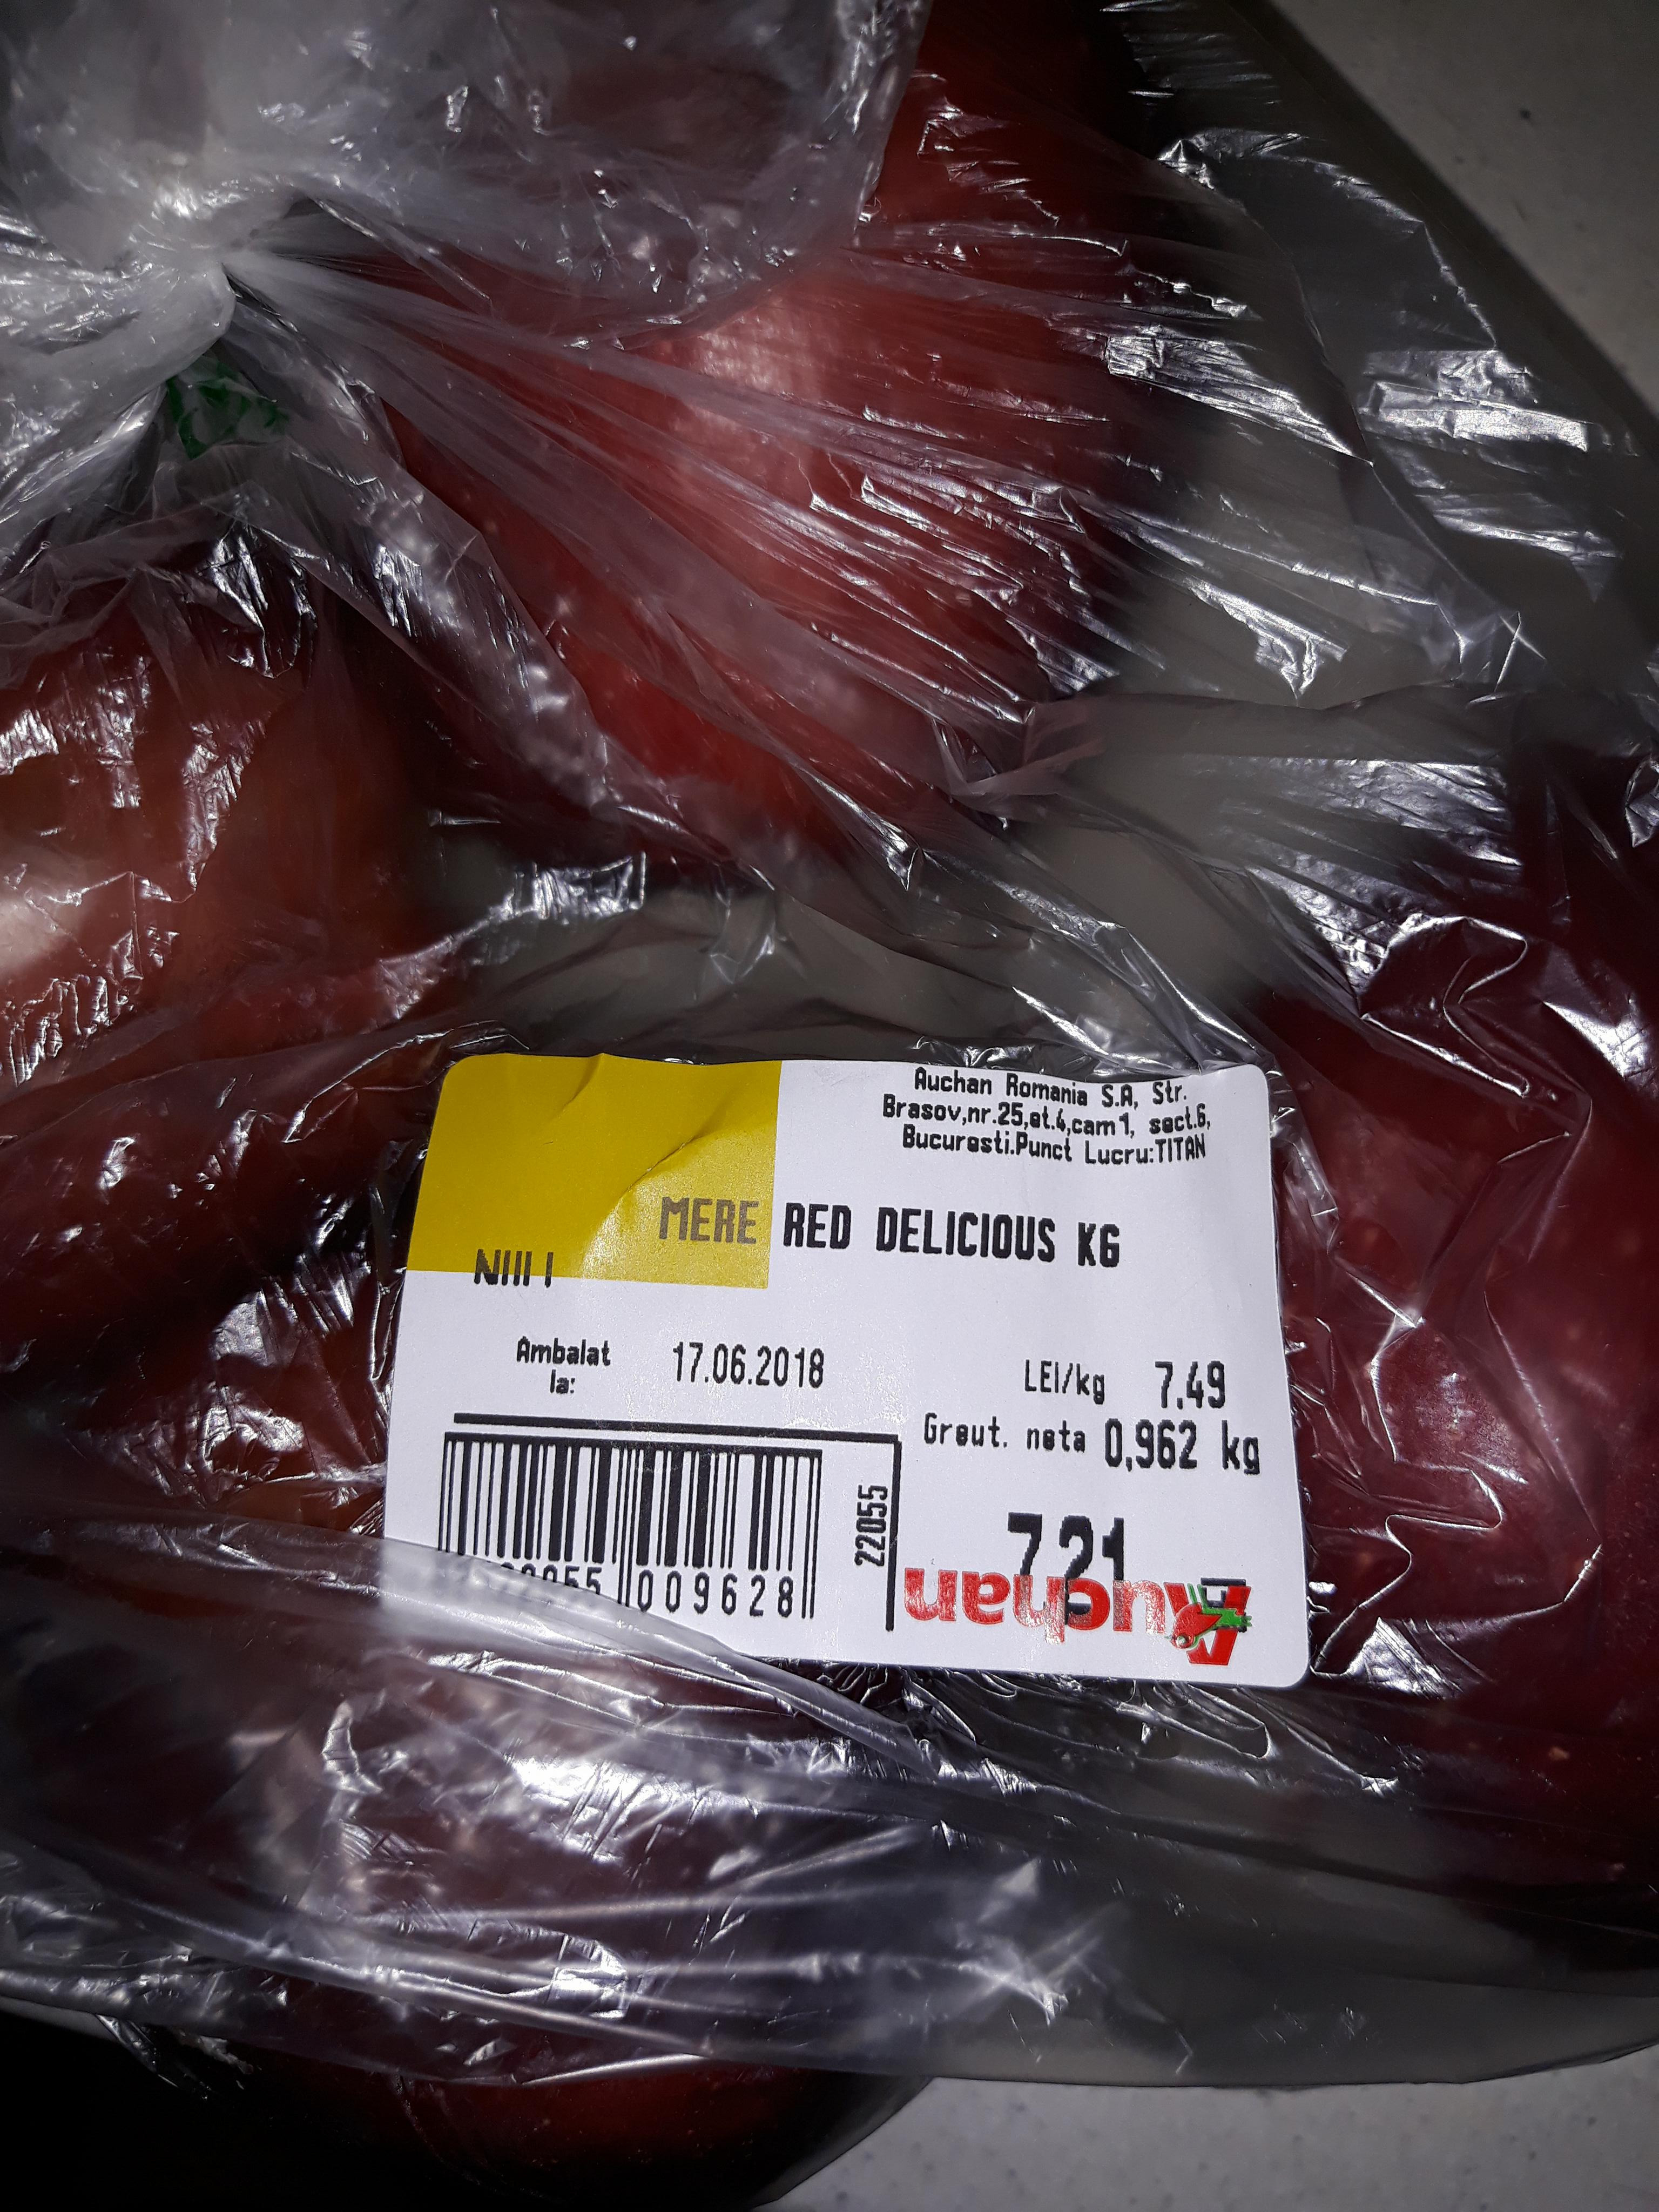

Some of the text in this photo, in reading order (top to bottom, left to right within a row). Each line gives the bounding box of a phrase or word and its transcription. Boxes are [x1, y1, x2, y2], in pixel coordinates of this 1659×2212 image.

[914, 1066, 992, 1095] Auchan
[1006, 1072, 1088, 1106] Romania
[1152, 1080, 1187, 1105] Str.
[659, 1196, 1120, 1267] MERE RED DELICIOUS KG
[516, 1336, 824, 1388] Ambalat 17.06.2018
[1024, 1359, 1225, 1409] LEI/kg 7.49
[923, 1412, 1260, 1475] Greut. neta 0,962 kg
[854, 1484, 888, 1567] 22055
[904, 1567, 1253, 1665] Auchan
